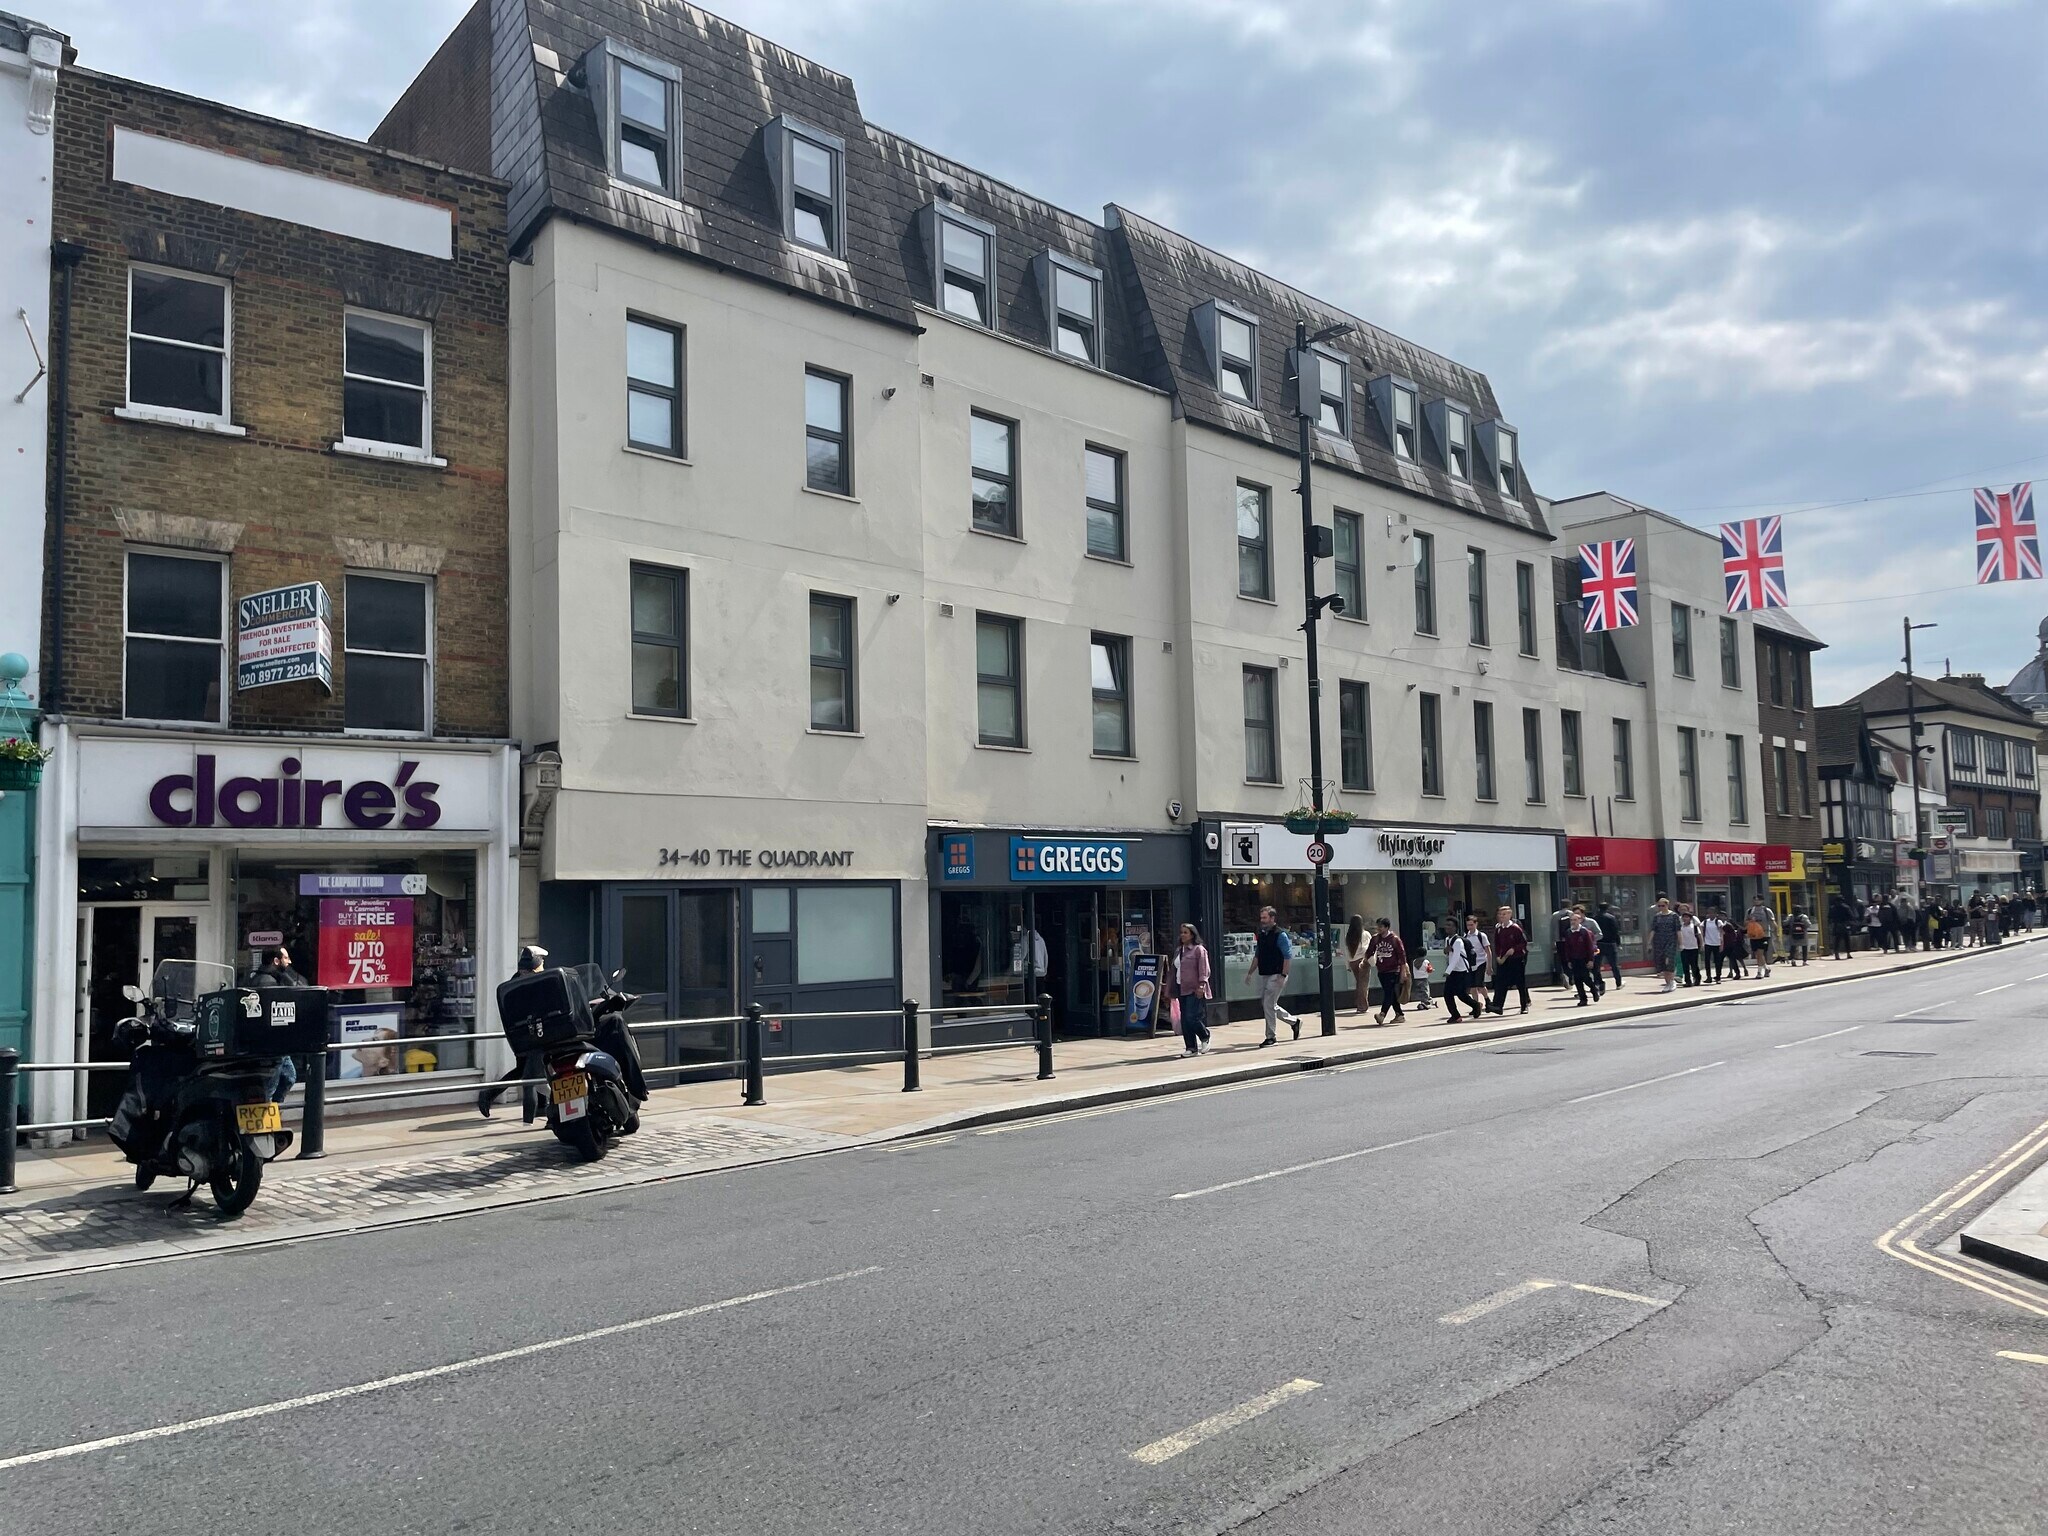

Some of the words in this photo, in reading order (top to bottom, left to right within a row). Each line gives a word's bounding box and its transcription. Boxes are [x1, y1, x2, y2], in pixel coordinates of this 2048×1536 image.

[241, 588, 315, 628] SNELLER
[250, 608, 310, 626] COMMERCIAL
[240, 629, 270, 641] FREEHOLD
[271, 620, 317, 634] INVESTMENT
[259, 639, 272, 647] FOR
[273, 635, 291, 645] SALE
[240, 650, 269, 661] BUSINESS
[270, 641, 316, 656] UNAFFECTED
[240, 672, 256, 686] 020
[258, 667, 284, 683] 8977
[286, 662, 315, 678] 2204
[1377, 833, 1415, 857] flying
[659, 848, 711, 866] 34-40
[717, 849, 752, 866] THE
[758, 850, 854, 868] QUADRANT
[1040, 846, 1124, 874] GREGGS
[1309, 848, 1324, 858] 20
[1704, 852, 1730, 865] FLIGHT
[1730, 852, 1756, 866] CENTRE
[947, 865, 971, 875] GREGGS
[133, 890, 148, 899] 33
[358, 912, 395, 925] FREE
[354, 929, 381, 941] sale!
[348, 942, 366, 958] UP
[367, 942, 385, 958] TO
[374, 974, 391, 983] OFF
[558, 1086, 581, 1101] HTV
[239, 1106, 276, 1119] RK70
[565, 1102, 578, 1115] L
